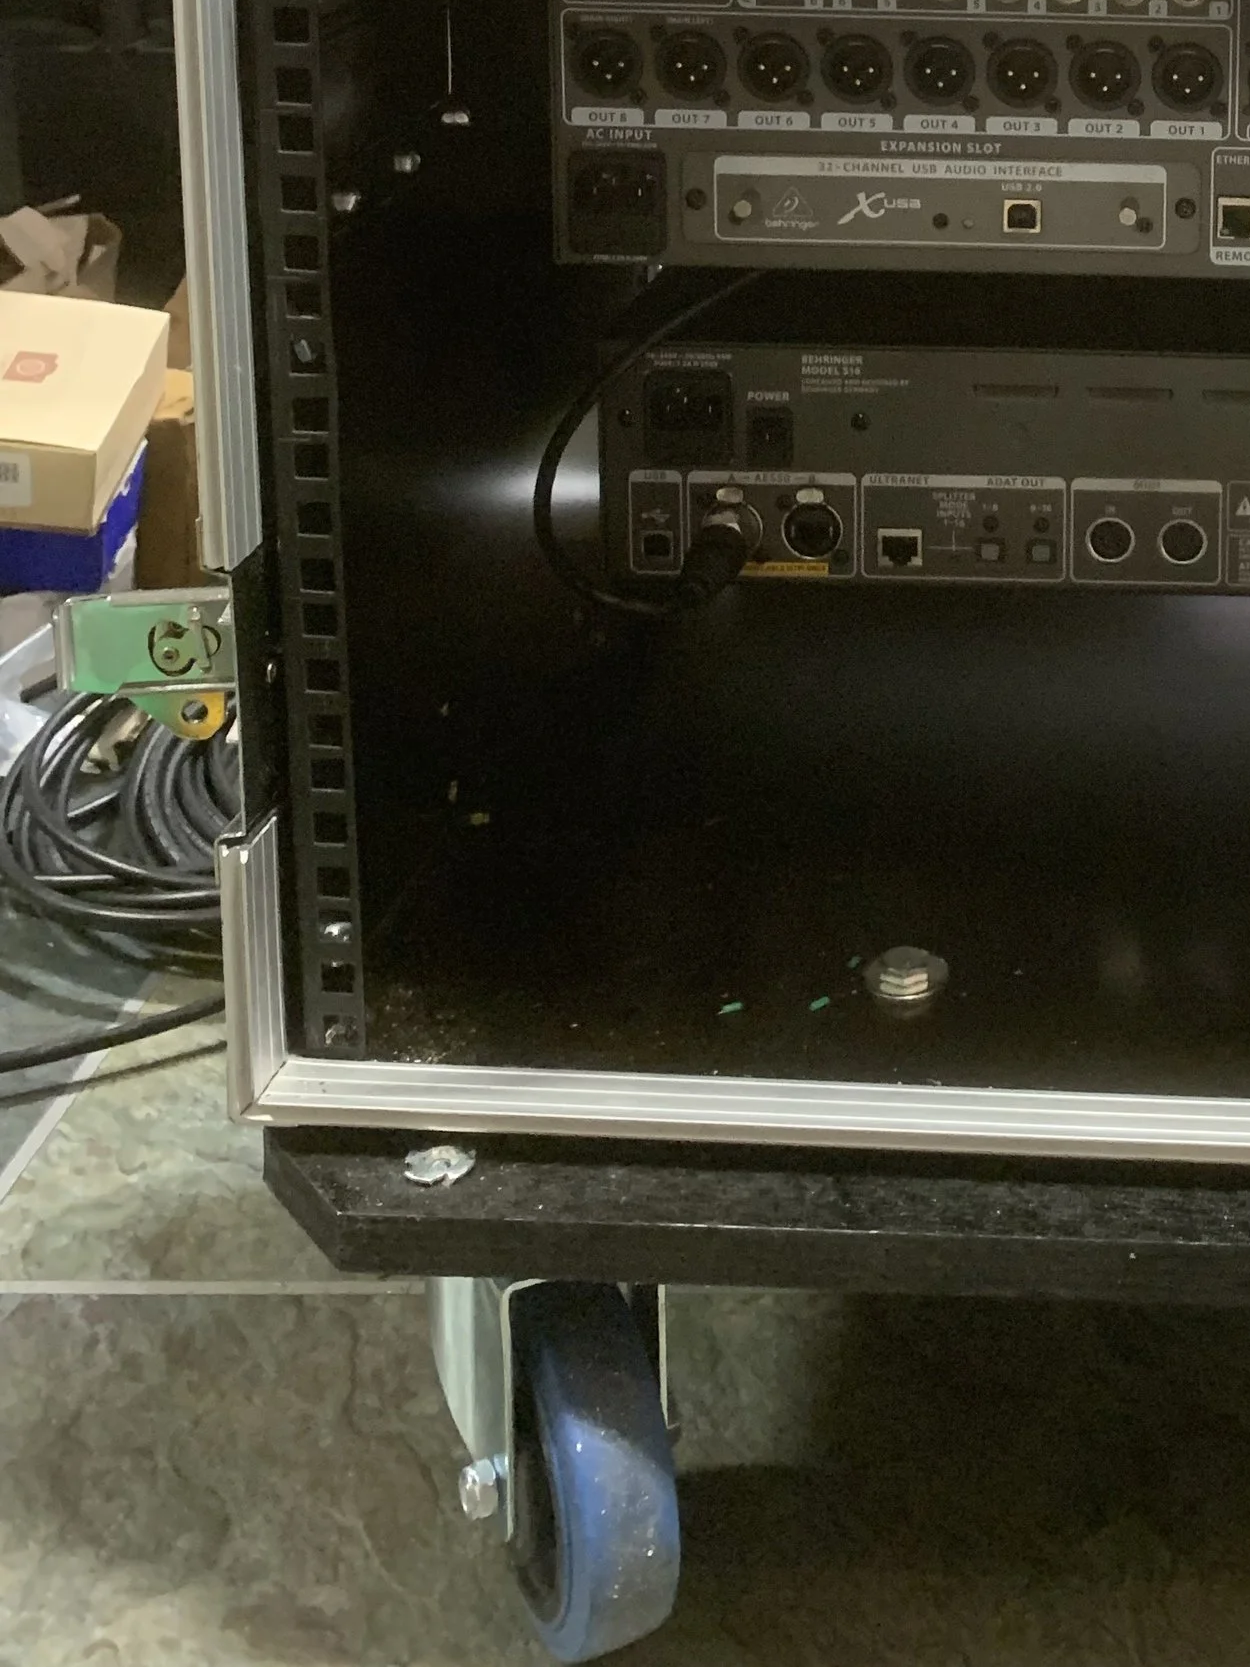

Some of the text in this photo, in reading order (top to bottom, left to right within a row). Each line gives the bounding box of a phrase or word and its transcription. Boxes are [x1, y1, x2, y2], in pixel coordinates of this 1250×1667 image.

[1033, 1, 1041, 11] 4
[589, 112, 627, 123] OUT 8
[672, 113, 710, 124] OUT 7
[755, 114, 793, 126] OUT 6
[838, 116, 876, 128] OUT 5
[920, 118, 959, 130] OUT 4
[1003, 120, 1041, 132] OUT 3
[1085, 122, 1124, 134] OUT 2
[1168, 124, 1206, 136] OUT 1
[586, 128, 653, 142] AC INPUT
[881, 140, 1002, 155] EXPANSION SLOT
[912, 162, 937, 174] USB
[944, 163, 987, 176] AUDIO
[993, 164, 1063, 177] INTERFACE
[801, 354, 863, 364] BEHRINGER
[747, 391, 790, 402] POWER
[869, 477, 929, 486] ULTRANET
[987, 478, 1046, 488] ADAT OUT
